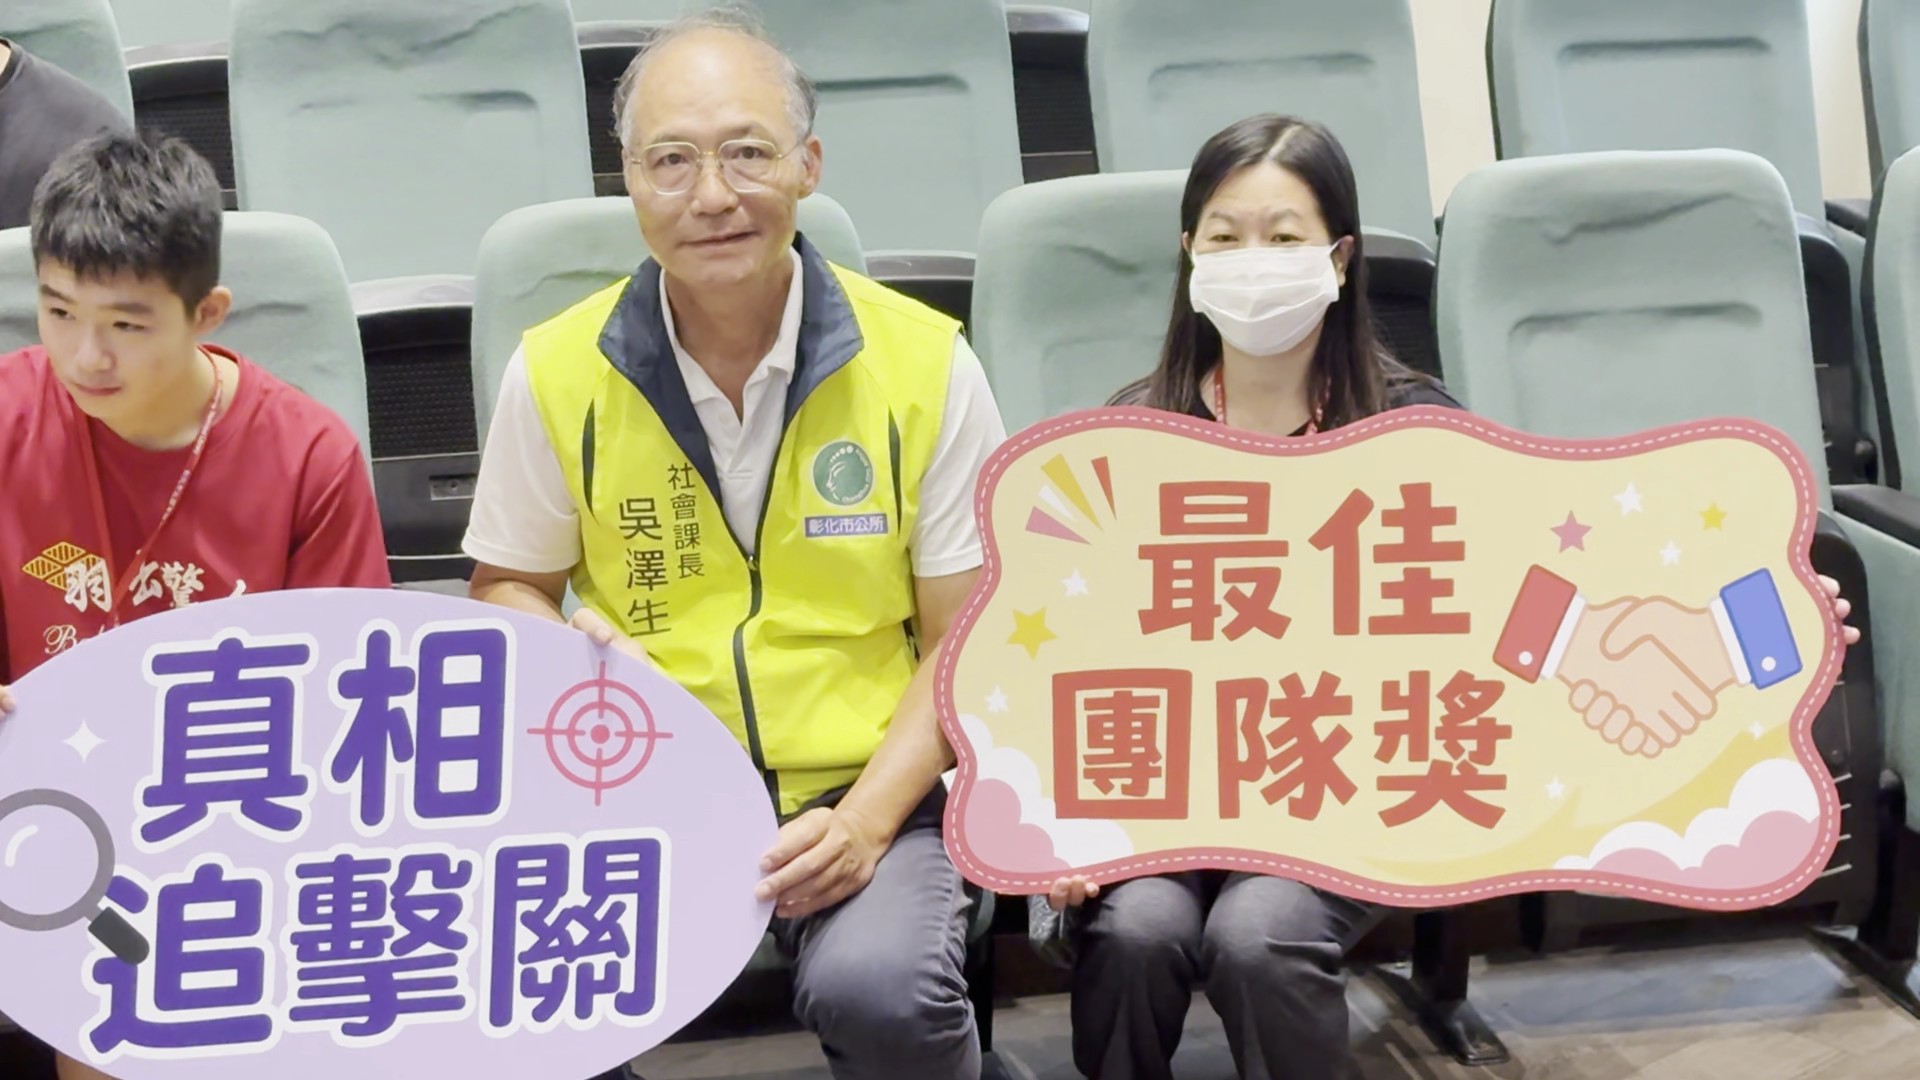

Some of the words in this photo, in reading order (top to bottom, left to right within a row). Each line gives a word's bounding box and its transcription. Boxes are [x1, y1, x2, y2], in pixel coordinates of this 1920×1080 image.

[618, 497, 672, 638] 吳澤生
[667, 462, 705, 580] 社會課長
[808, 515, 884, 535] 彰化市公所
[1137, 480, 1471, 642] 最佳
[140, 627, 507, 844] 真相
[1051, 667, 1513, 830] 團隊獎
[90, 837, 661, 1055] 追擊關
